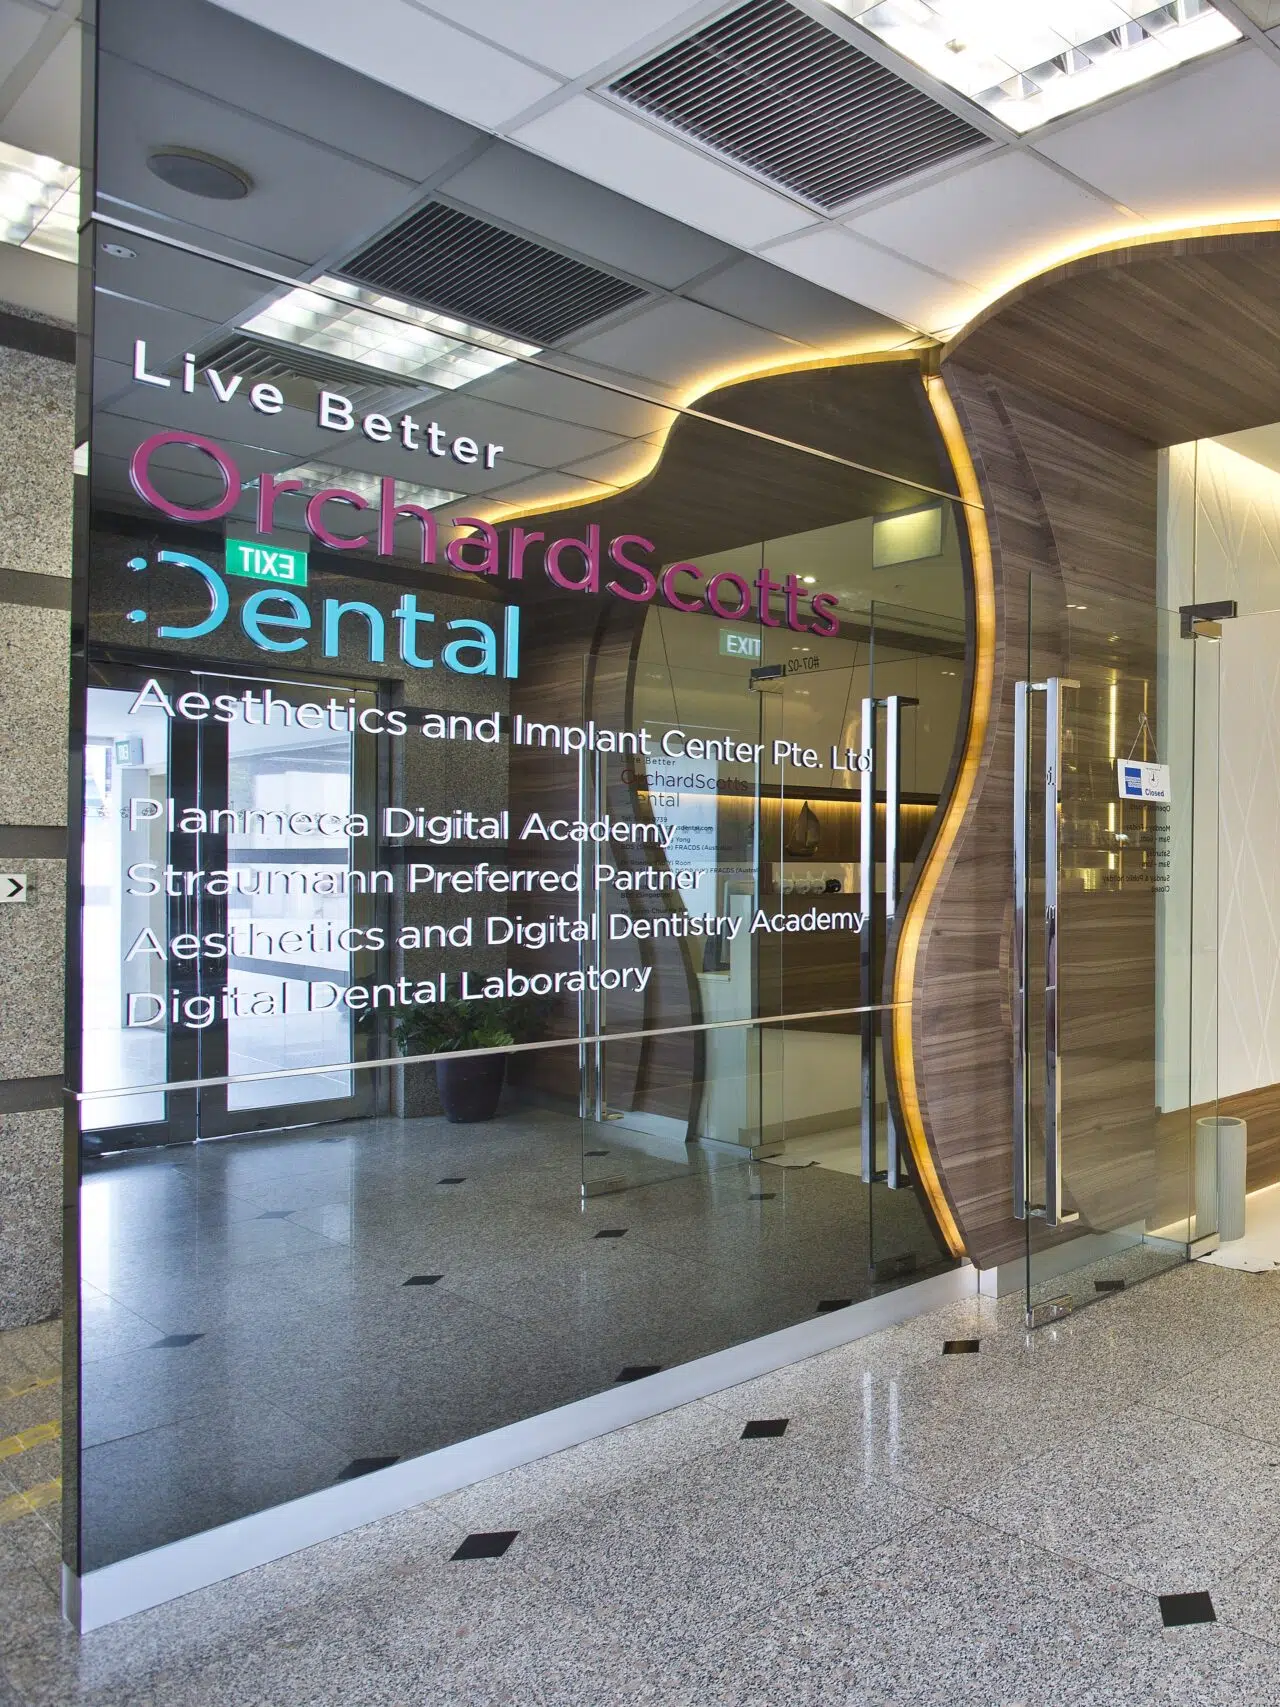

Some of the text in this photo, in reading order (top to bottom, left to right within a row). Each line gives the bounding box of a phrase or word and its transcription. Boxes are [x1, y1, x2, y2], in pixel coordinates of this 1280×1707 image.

[133, 340, 504, 469] Live Better
[129, 431, 840, 637] OrchardScotts
[727, 634, 760, 656] EXIT
[128, 678, 873, 774] Aesthetics and Implant Center Pte. Ltd
[621, 769, 748, 791] OrchardScotts
[645, 757, 676, 766] Better
[128, 797, 677, 848] Planmeca Digital Academy
[125, 862, 706, 897] Straumann Preferred Partner
[124, 907, 867, 962] Aesthetics and Digital Dentistry Academy
[126, 965, 653, 1029] Digital Dental Laboratory
